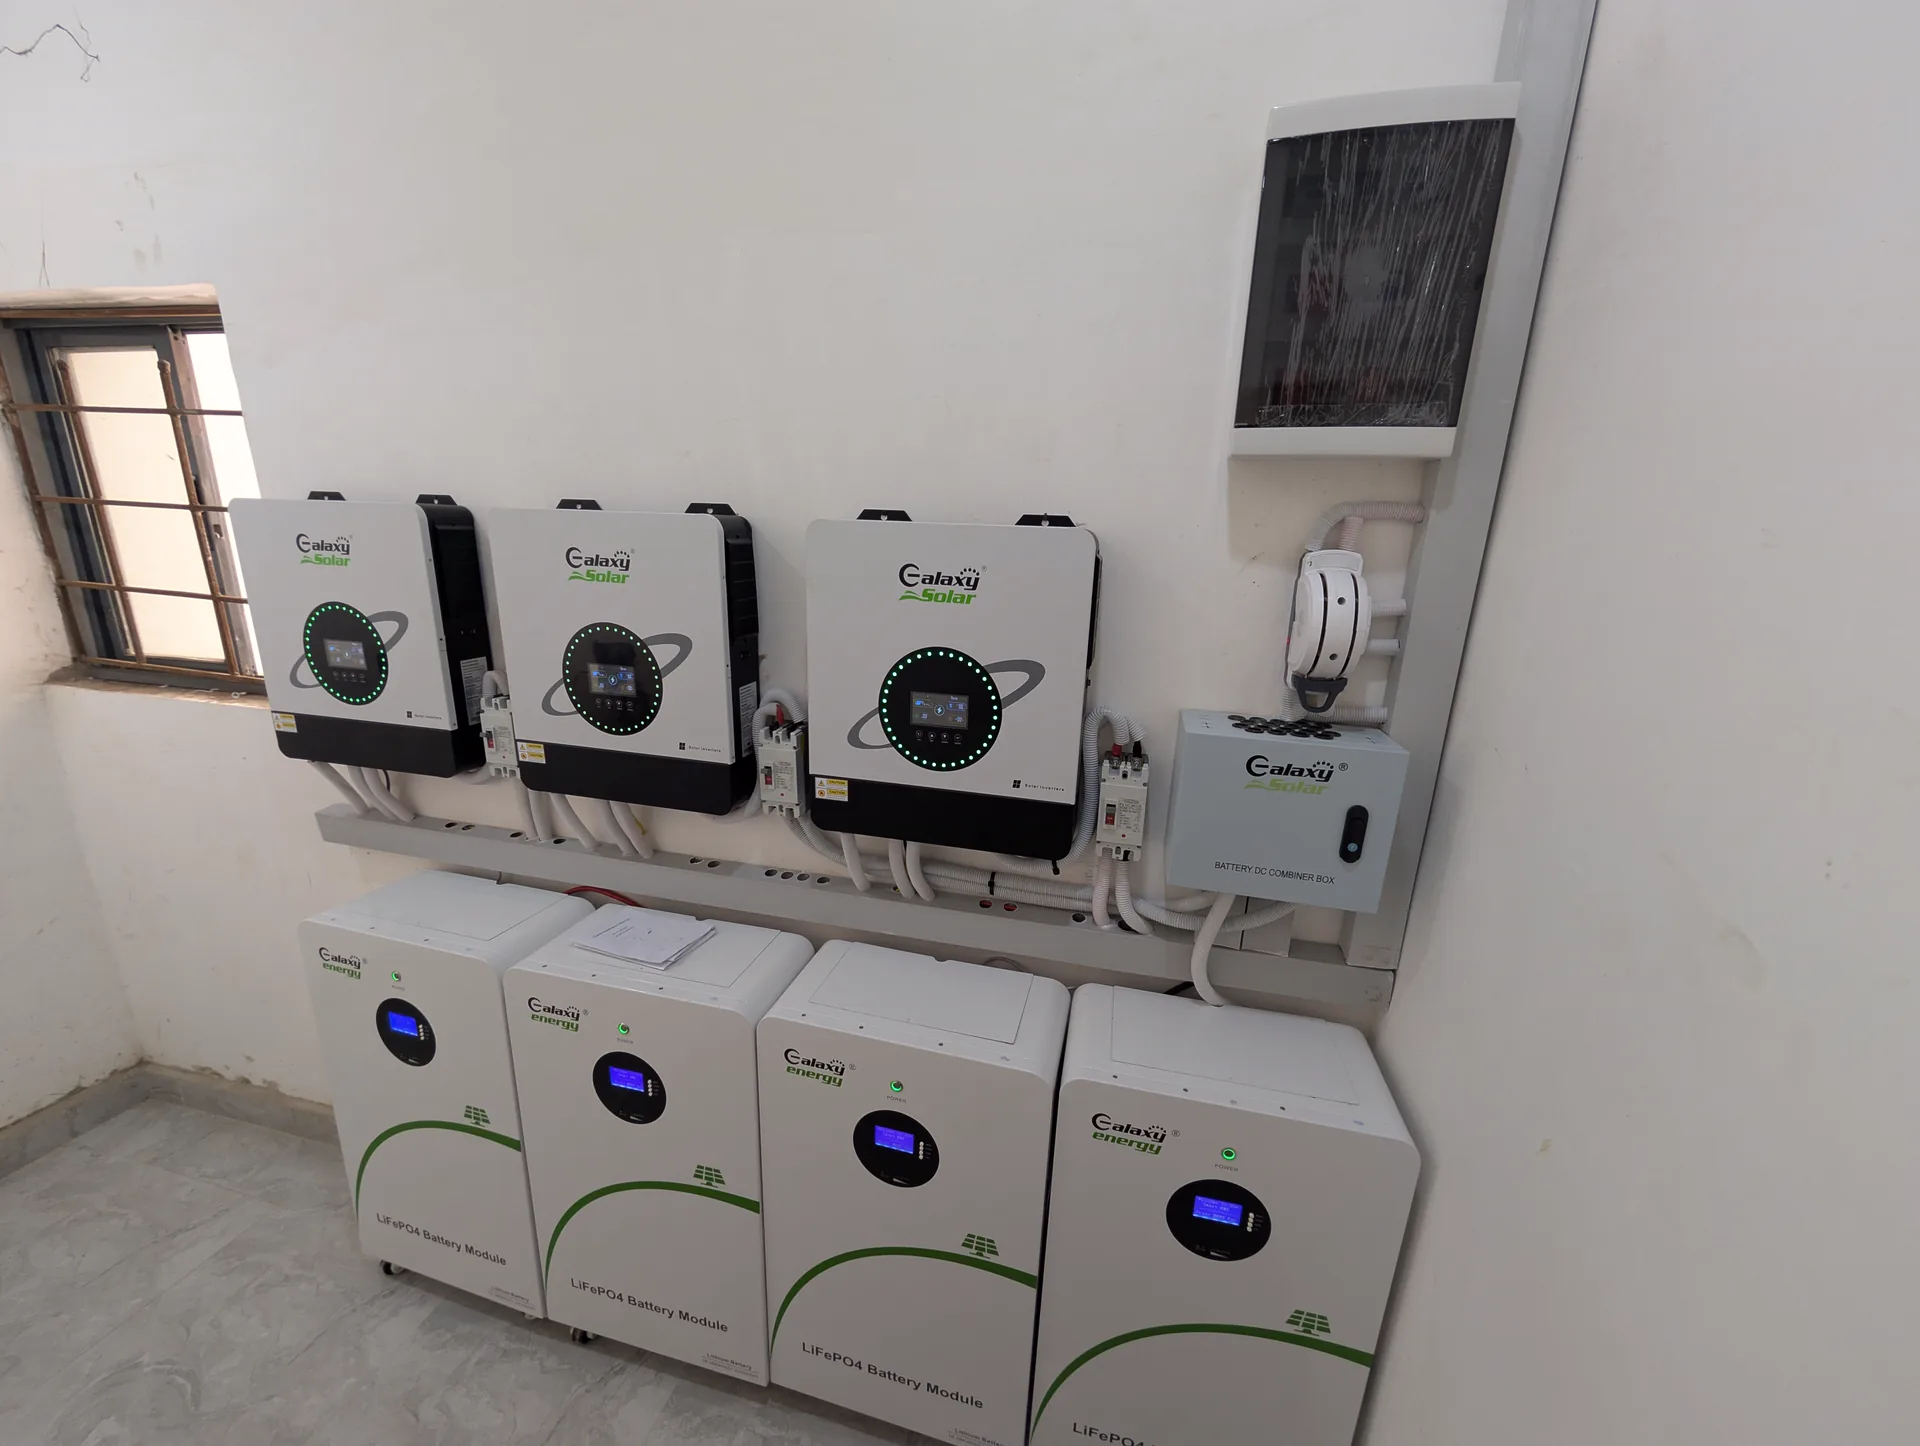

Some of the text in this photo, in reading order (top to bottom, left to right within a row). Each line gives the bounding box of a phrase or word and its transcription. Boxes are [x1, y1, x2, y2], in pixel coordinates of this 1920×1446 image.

[296, 533, 350, 555] Galaxy
[314, 553, 351, 567] Solar
[565, 546, 630, 572] Galaxy
[585, 569, 630, 584] Solar
[899, 563, 980, 591] Galaxy
[921, 588, 977, 605] Solar
[1246, 755, 1334, 783] Galaxy
[1269, 778, 1330, 795] Solar
[1214, 861, 1336, 885] BATTERY DC COMBINER BOX
[319, 947, 361, 970] Galaxy
[322, 962, 361, 980] energy
[528, 997, 580, 1022] Galaxy
[531, 1014, 579, 1032] energy
[784, 1048, 846, 1077] Galaxy
[786, 1066, 843, 1088] energy
[1092, 1113, 1167, 1143] Galaxy
[1092, 1132, 1163, 1155] energy
[376, 1212, 507, 1266] LiFePO4 Battery Module
[571, 1278, 729, 1333] LiFePO4 Battery Module
[801, 1341, 984, 1409] LiFePO4 Battery Module
